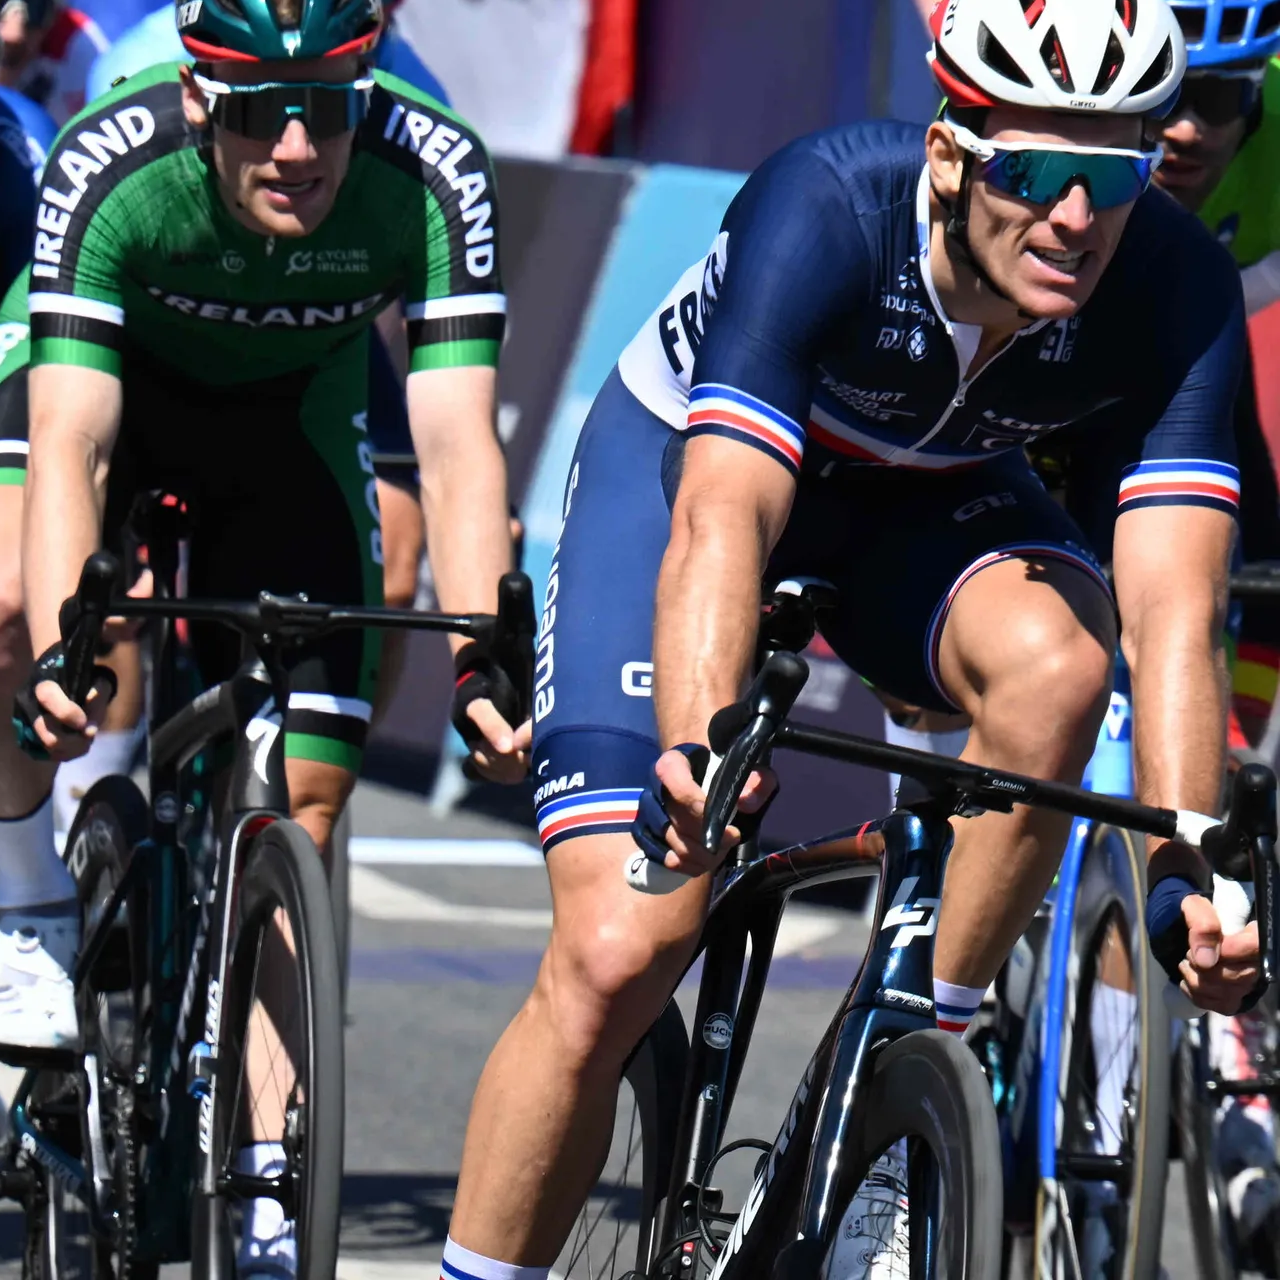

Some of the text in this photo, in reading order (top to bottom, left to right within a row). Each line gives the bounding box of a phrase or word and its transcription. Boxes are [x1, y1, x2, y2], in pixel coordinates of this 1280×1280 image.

[1069, 100, 1097, 109] GIRO
[32, 104, 156, 280] IRELAND
[383, 103, 494, 278] IRELAND
[315, 248, 370, 262] CYCLING
[316, 261, 370, 275] IRELAND
[147, 286, 385, 328] IRELAND
[992, 778, 1028, 793] GARMIN
